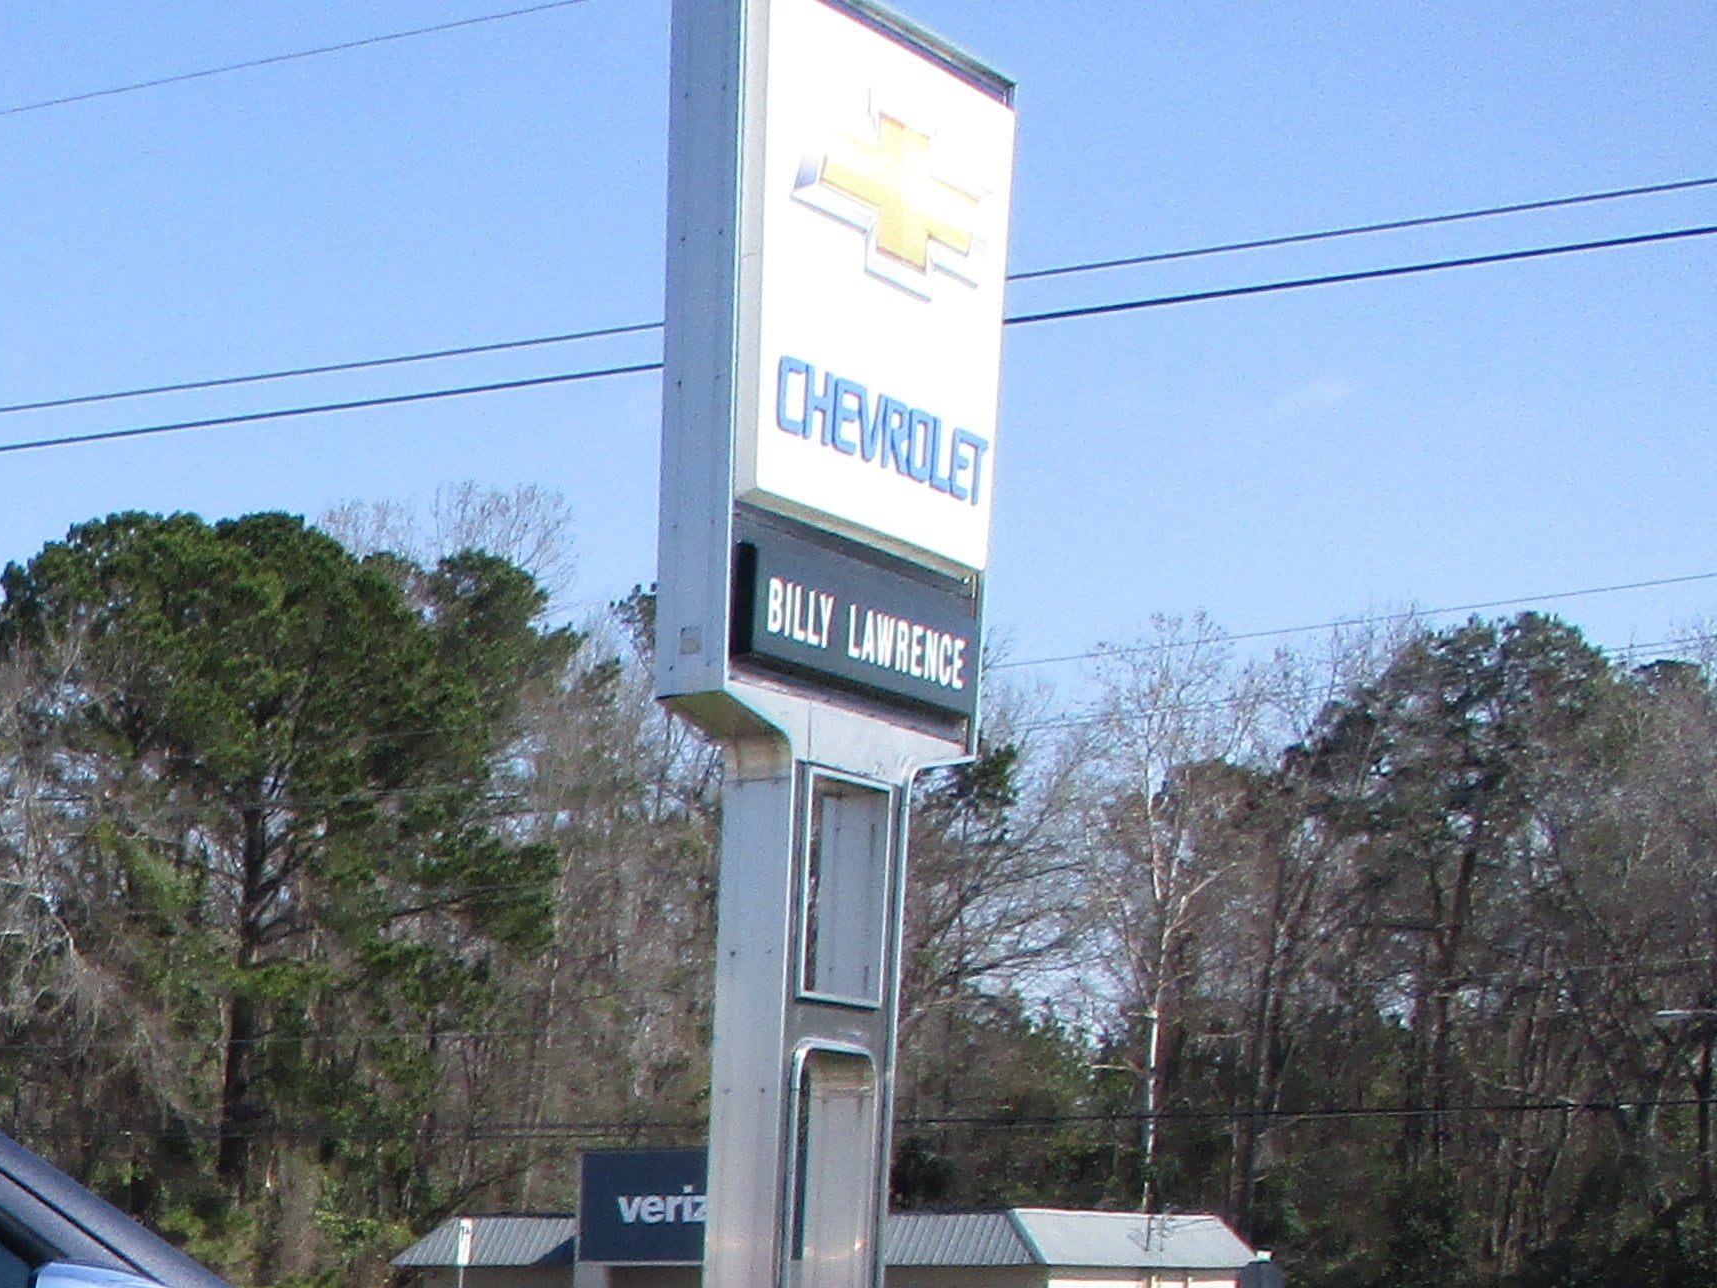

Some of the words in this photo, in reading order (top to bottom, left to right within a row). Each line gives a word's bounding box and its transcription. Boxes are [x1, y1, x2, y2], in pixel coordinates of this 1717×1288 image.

[776, 354, 989, 506] CHEVROLET
[767, 576, 835, 649] BILLY
[847, 603, 967, 690] LAWRENCE
[617, 1184, 707, 1225] veriz
